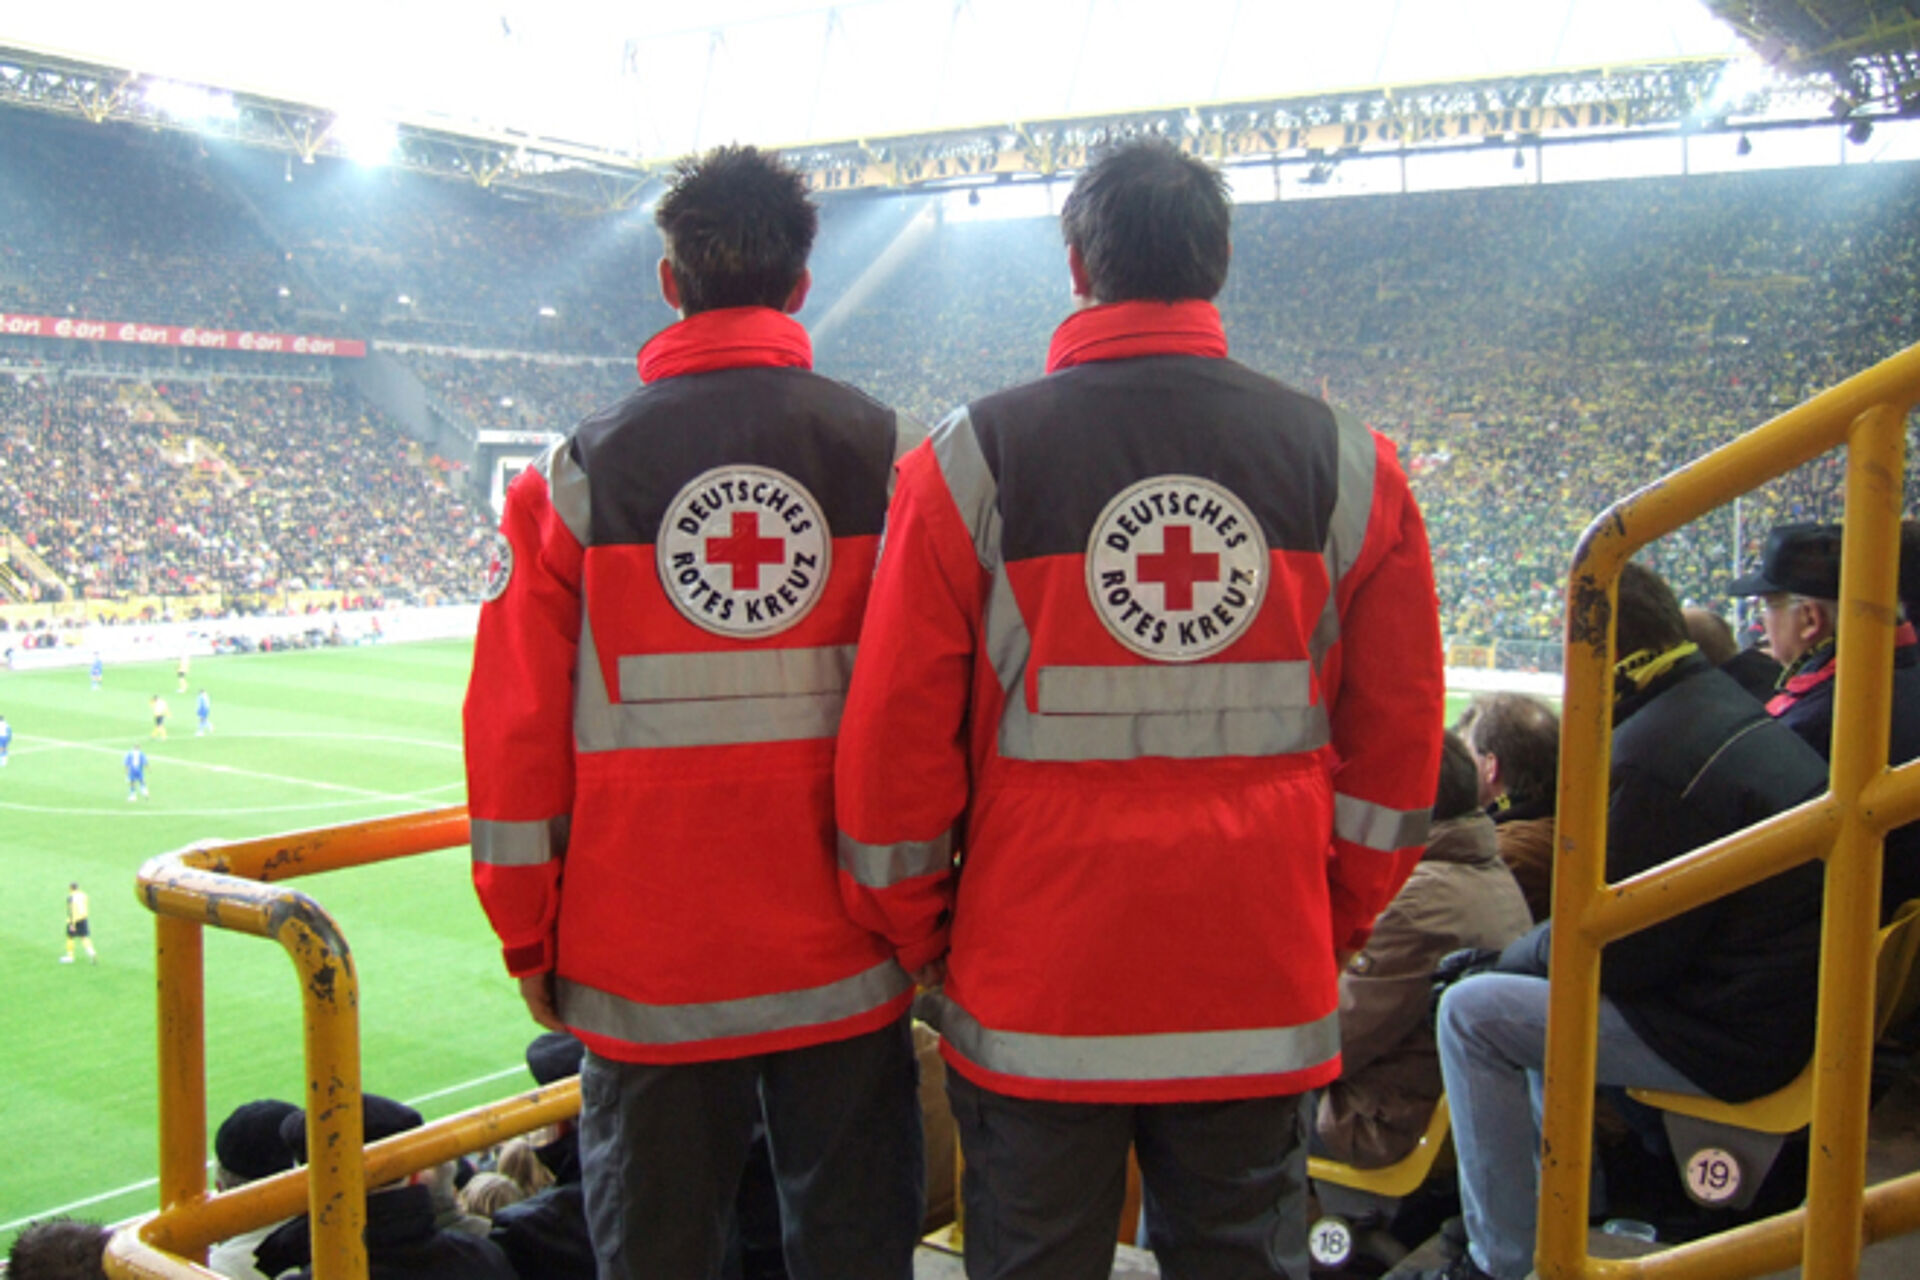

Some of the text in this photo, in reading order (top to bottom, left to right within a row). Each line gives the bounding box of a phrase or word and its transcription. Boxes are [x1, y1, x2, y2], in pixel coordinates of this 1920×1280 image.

[1343, 101, 1624, 144] DORTMUND
[677, 480, 812, 535] DEUTSCHES
[1106, 491, 1247, 553] DEUTSCHES
[672, 551, 817, 623] ROTES KREUZ
[1101, 567, 1254, 646] ROTES KREUZ
[1698, 1159, 1729, 1188] 19
[1320, 1231, 1344, 1254] 18
